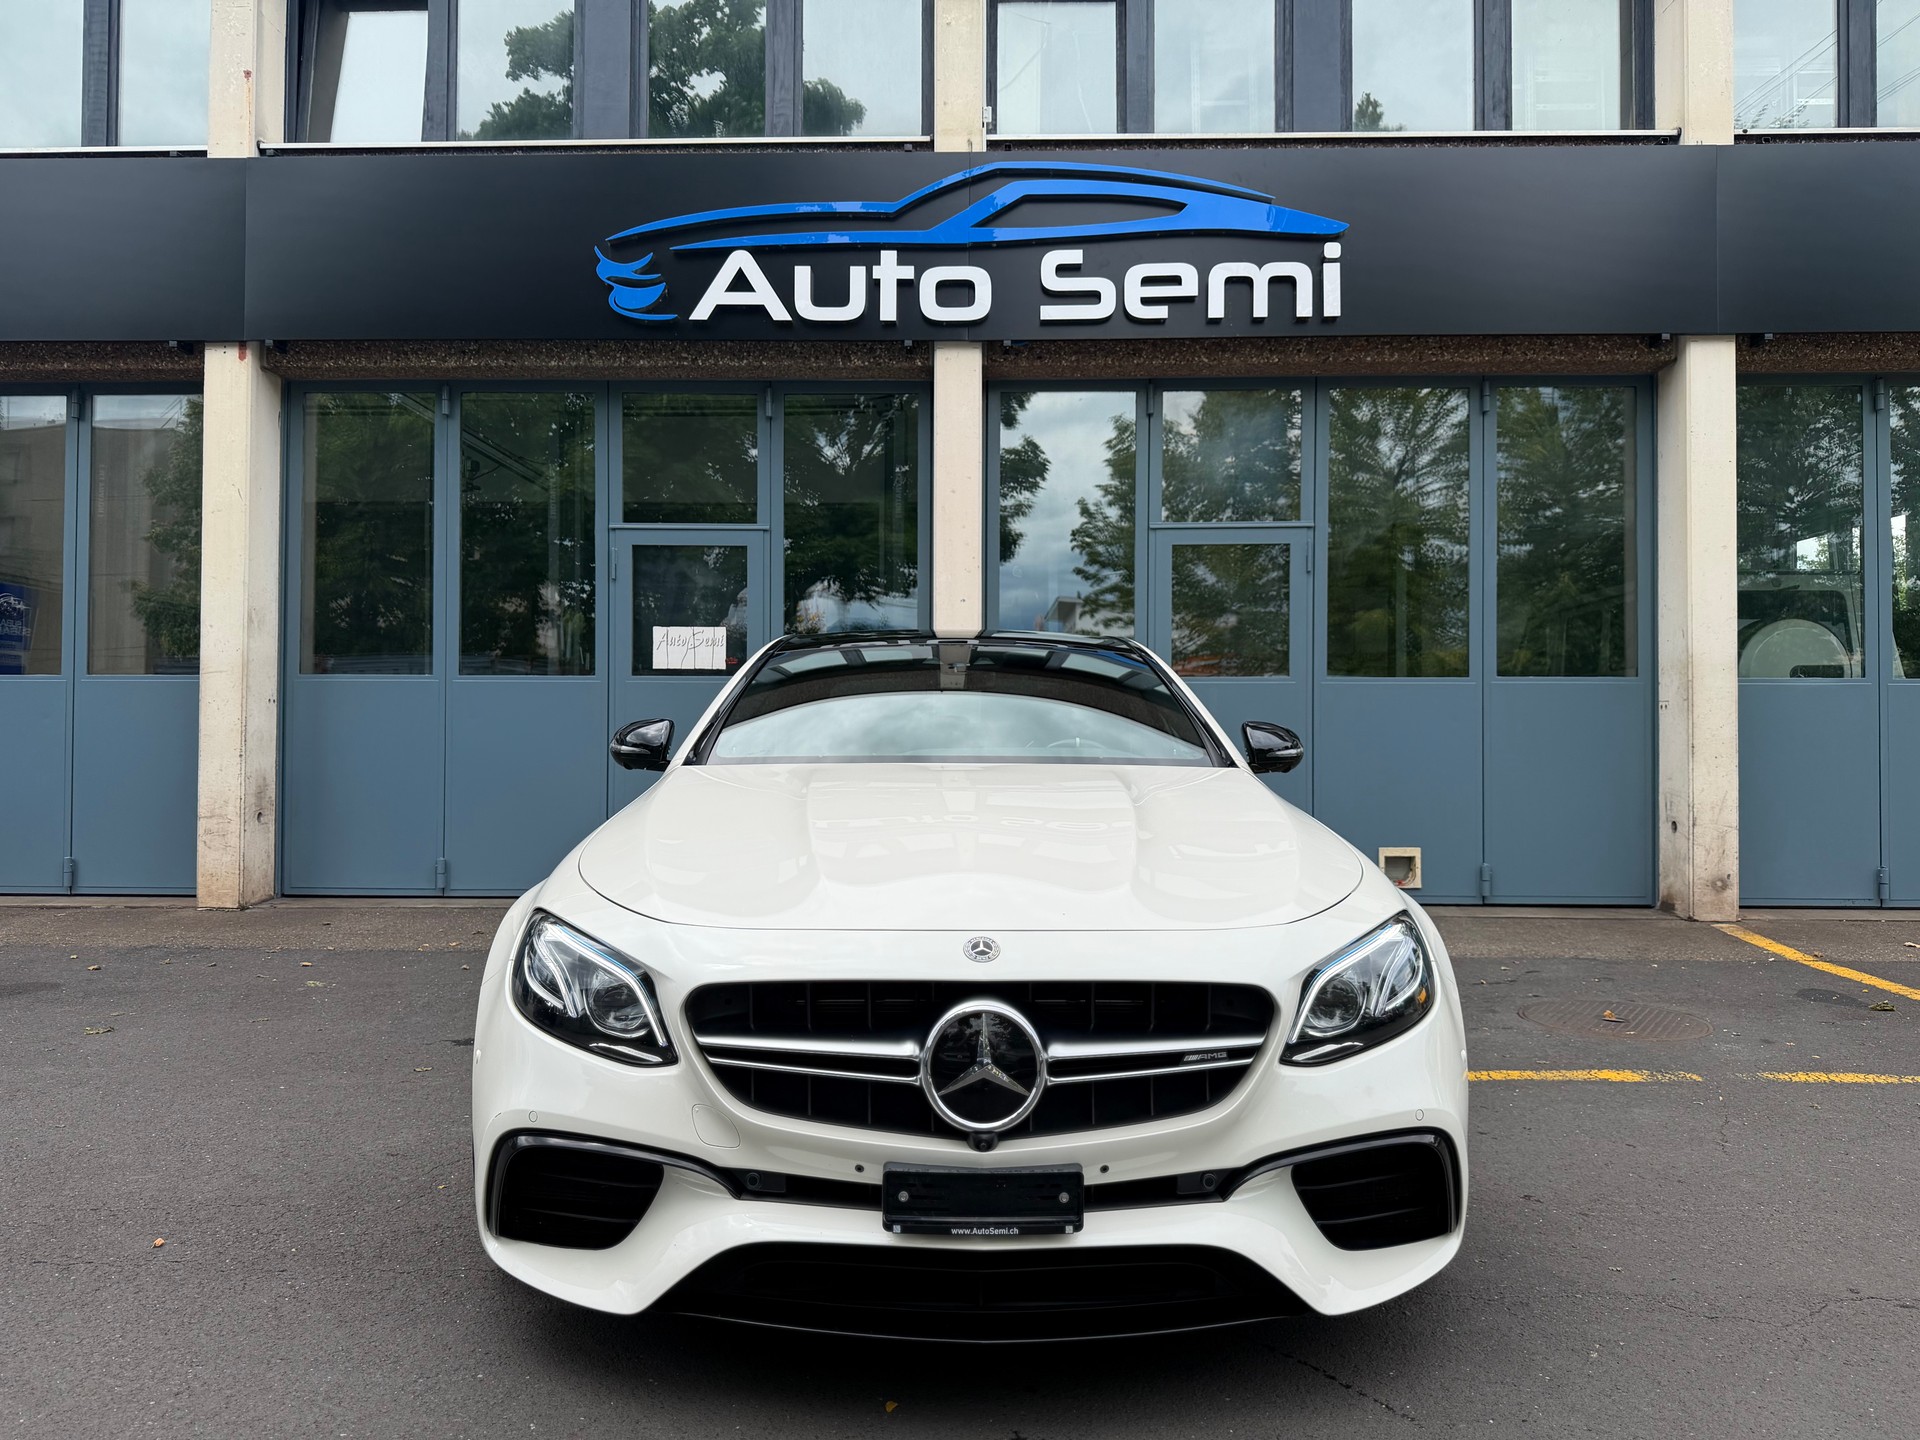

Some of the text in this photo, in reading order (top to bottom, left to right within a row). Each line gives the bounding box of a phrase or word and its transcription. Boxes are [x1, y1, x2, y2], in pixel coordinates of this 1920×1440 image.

[688, 241, 1342, 322] Auto Semi
[1197, 1051, 1228, 1060] AMG
[951, 1227, 1019, 1235] www.AutoSemi.ch
